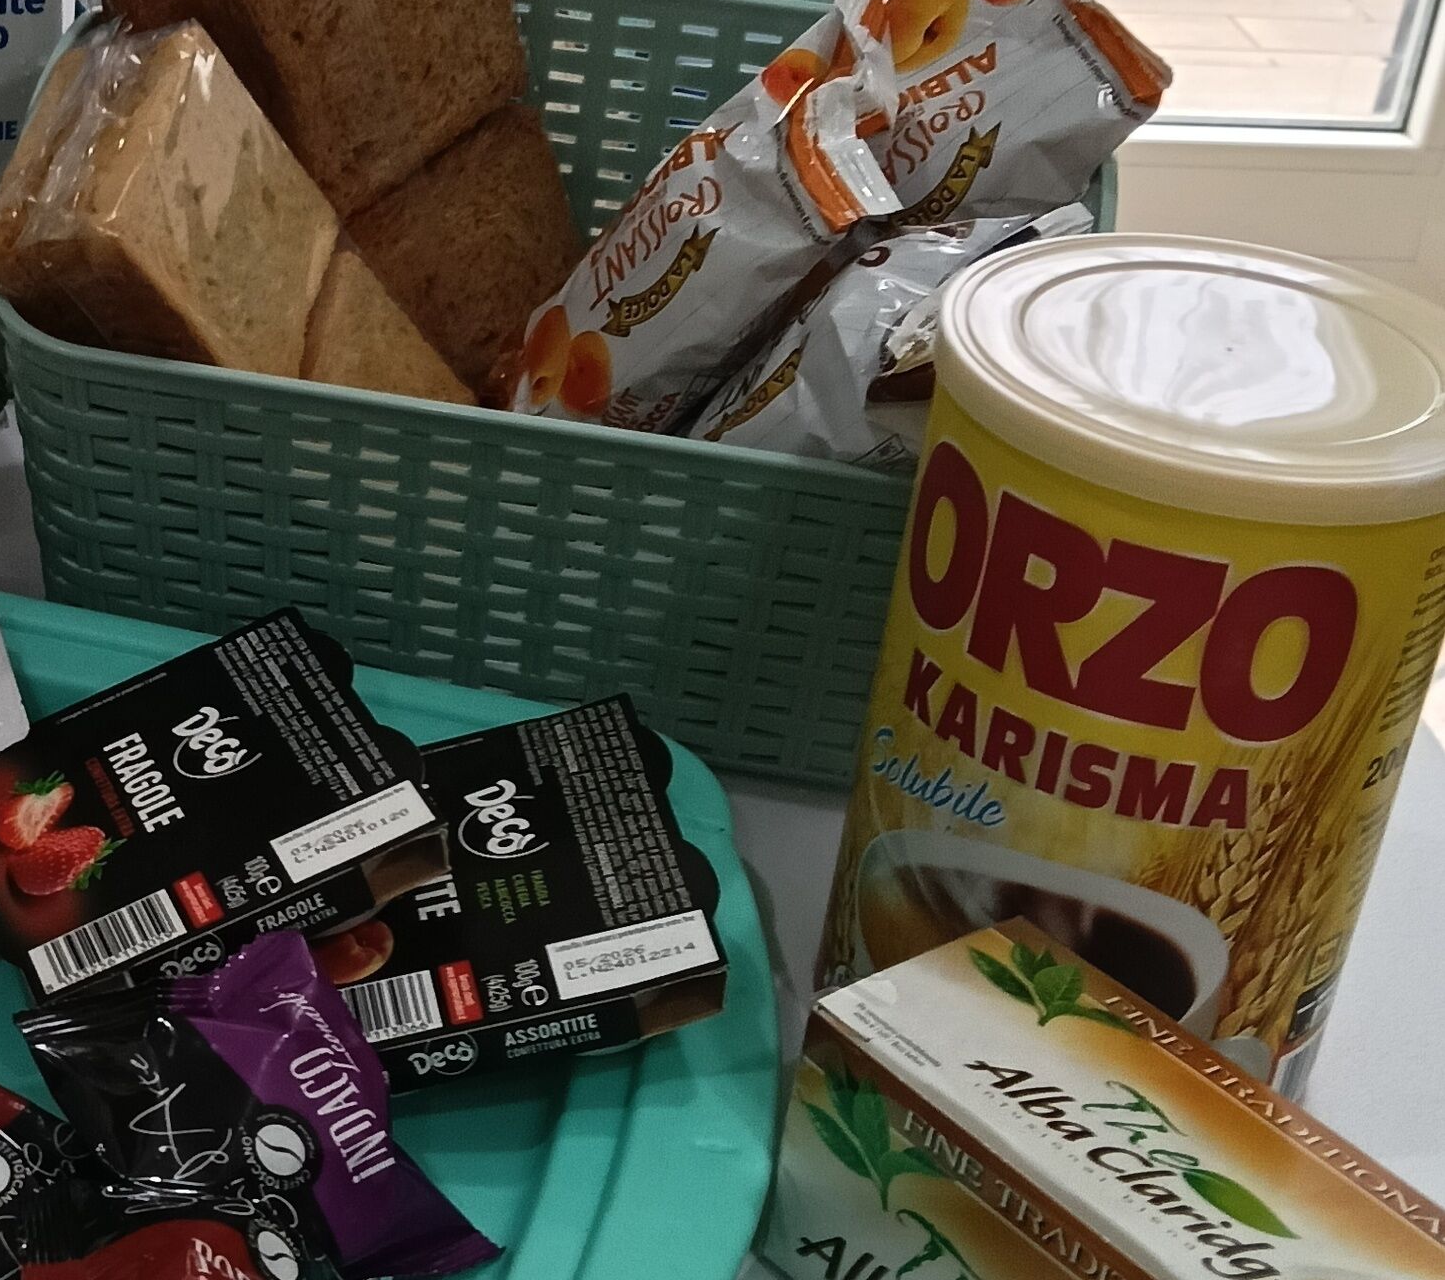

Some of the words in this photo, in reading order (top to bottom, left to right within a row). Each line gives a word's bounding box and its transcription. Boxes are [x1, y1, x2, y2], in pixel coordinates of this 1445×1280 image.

[882, 89, 986, 186] CROISSA
[590, 176, 723, 312] CROISSANT
[671, 252, 694, 277] LA
[623, 280, 671, 320] DOLCE
[908, 441, 1360, 744] ORZO
[102, 731, 186, 834] FRAGOLE
[869, 728, 1008, 828] Solubile
[902, 647, 1251, 832] KARISMA
[257, 892, 327, 933] FRAGOLE
[504, 1012, 599, 1048] ASSORTITE
[289, 1046, 397, 1185] INDACO
[903, 1110, 984, 1190] FINE
[963, 1058, 1097, 1144] Alba
[1103, 994, 1199, 1059] FINE
[1203, 1054, 1445, 1246] TRADITIONA
